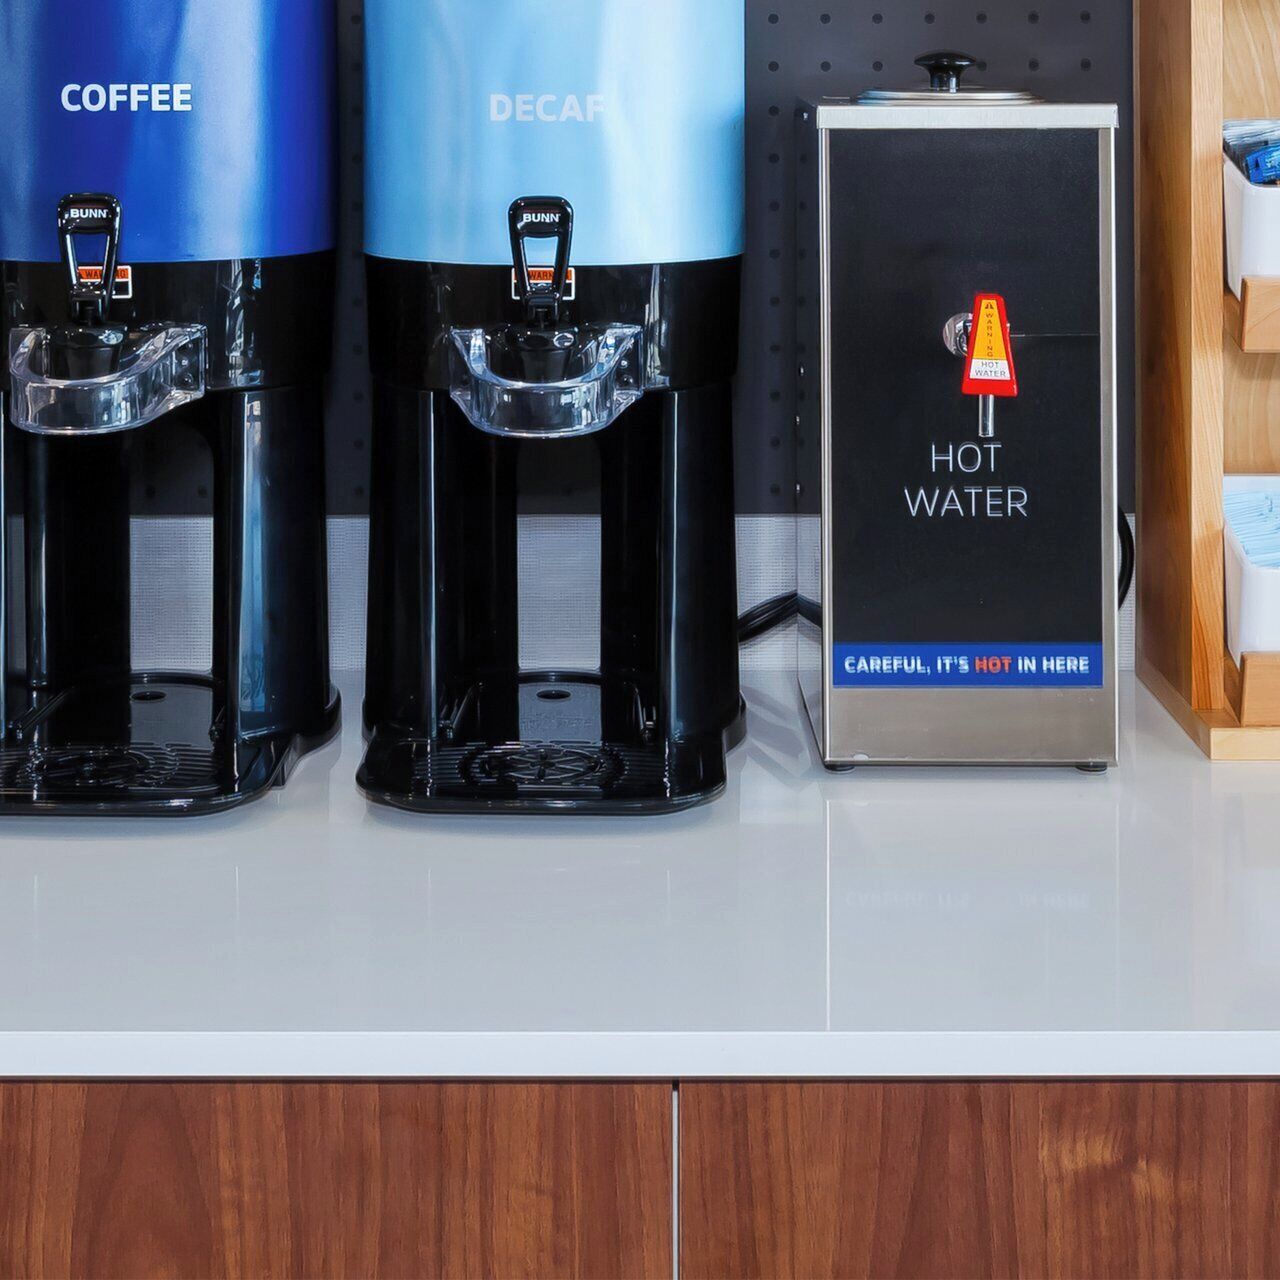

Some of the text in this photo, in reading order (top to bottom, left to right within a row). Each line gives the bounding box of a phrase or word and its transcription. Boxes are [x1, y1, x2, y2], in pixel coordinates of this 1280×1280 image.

[60, 83, 192, 112] COFFEE
[489, 93, 607, 122] DECAF
[70, 208, 107, 218] BUNN
[523, 213, 560, 223] BUNN
[930, 442, 1002, 473] HOT
[903, 486, 1028, 517] WATER
[844, 655, 1090, 676] CAREFUL, IT'S HOT IN HERE
